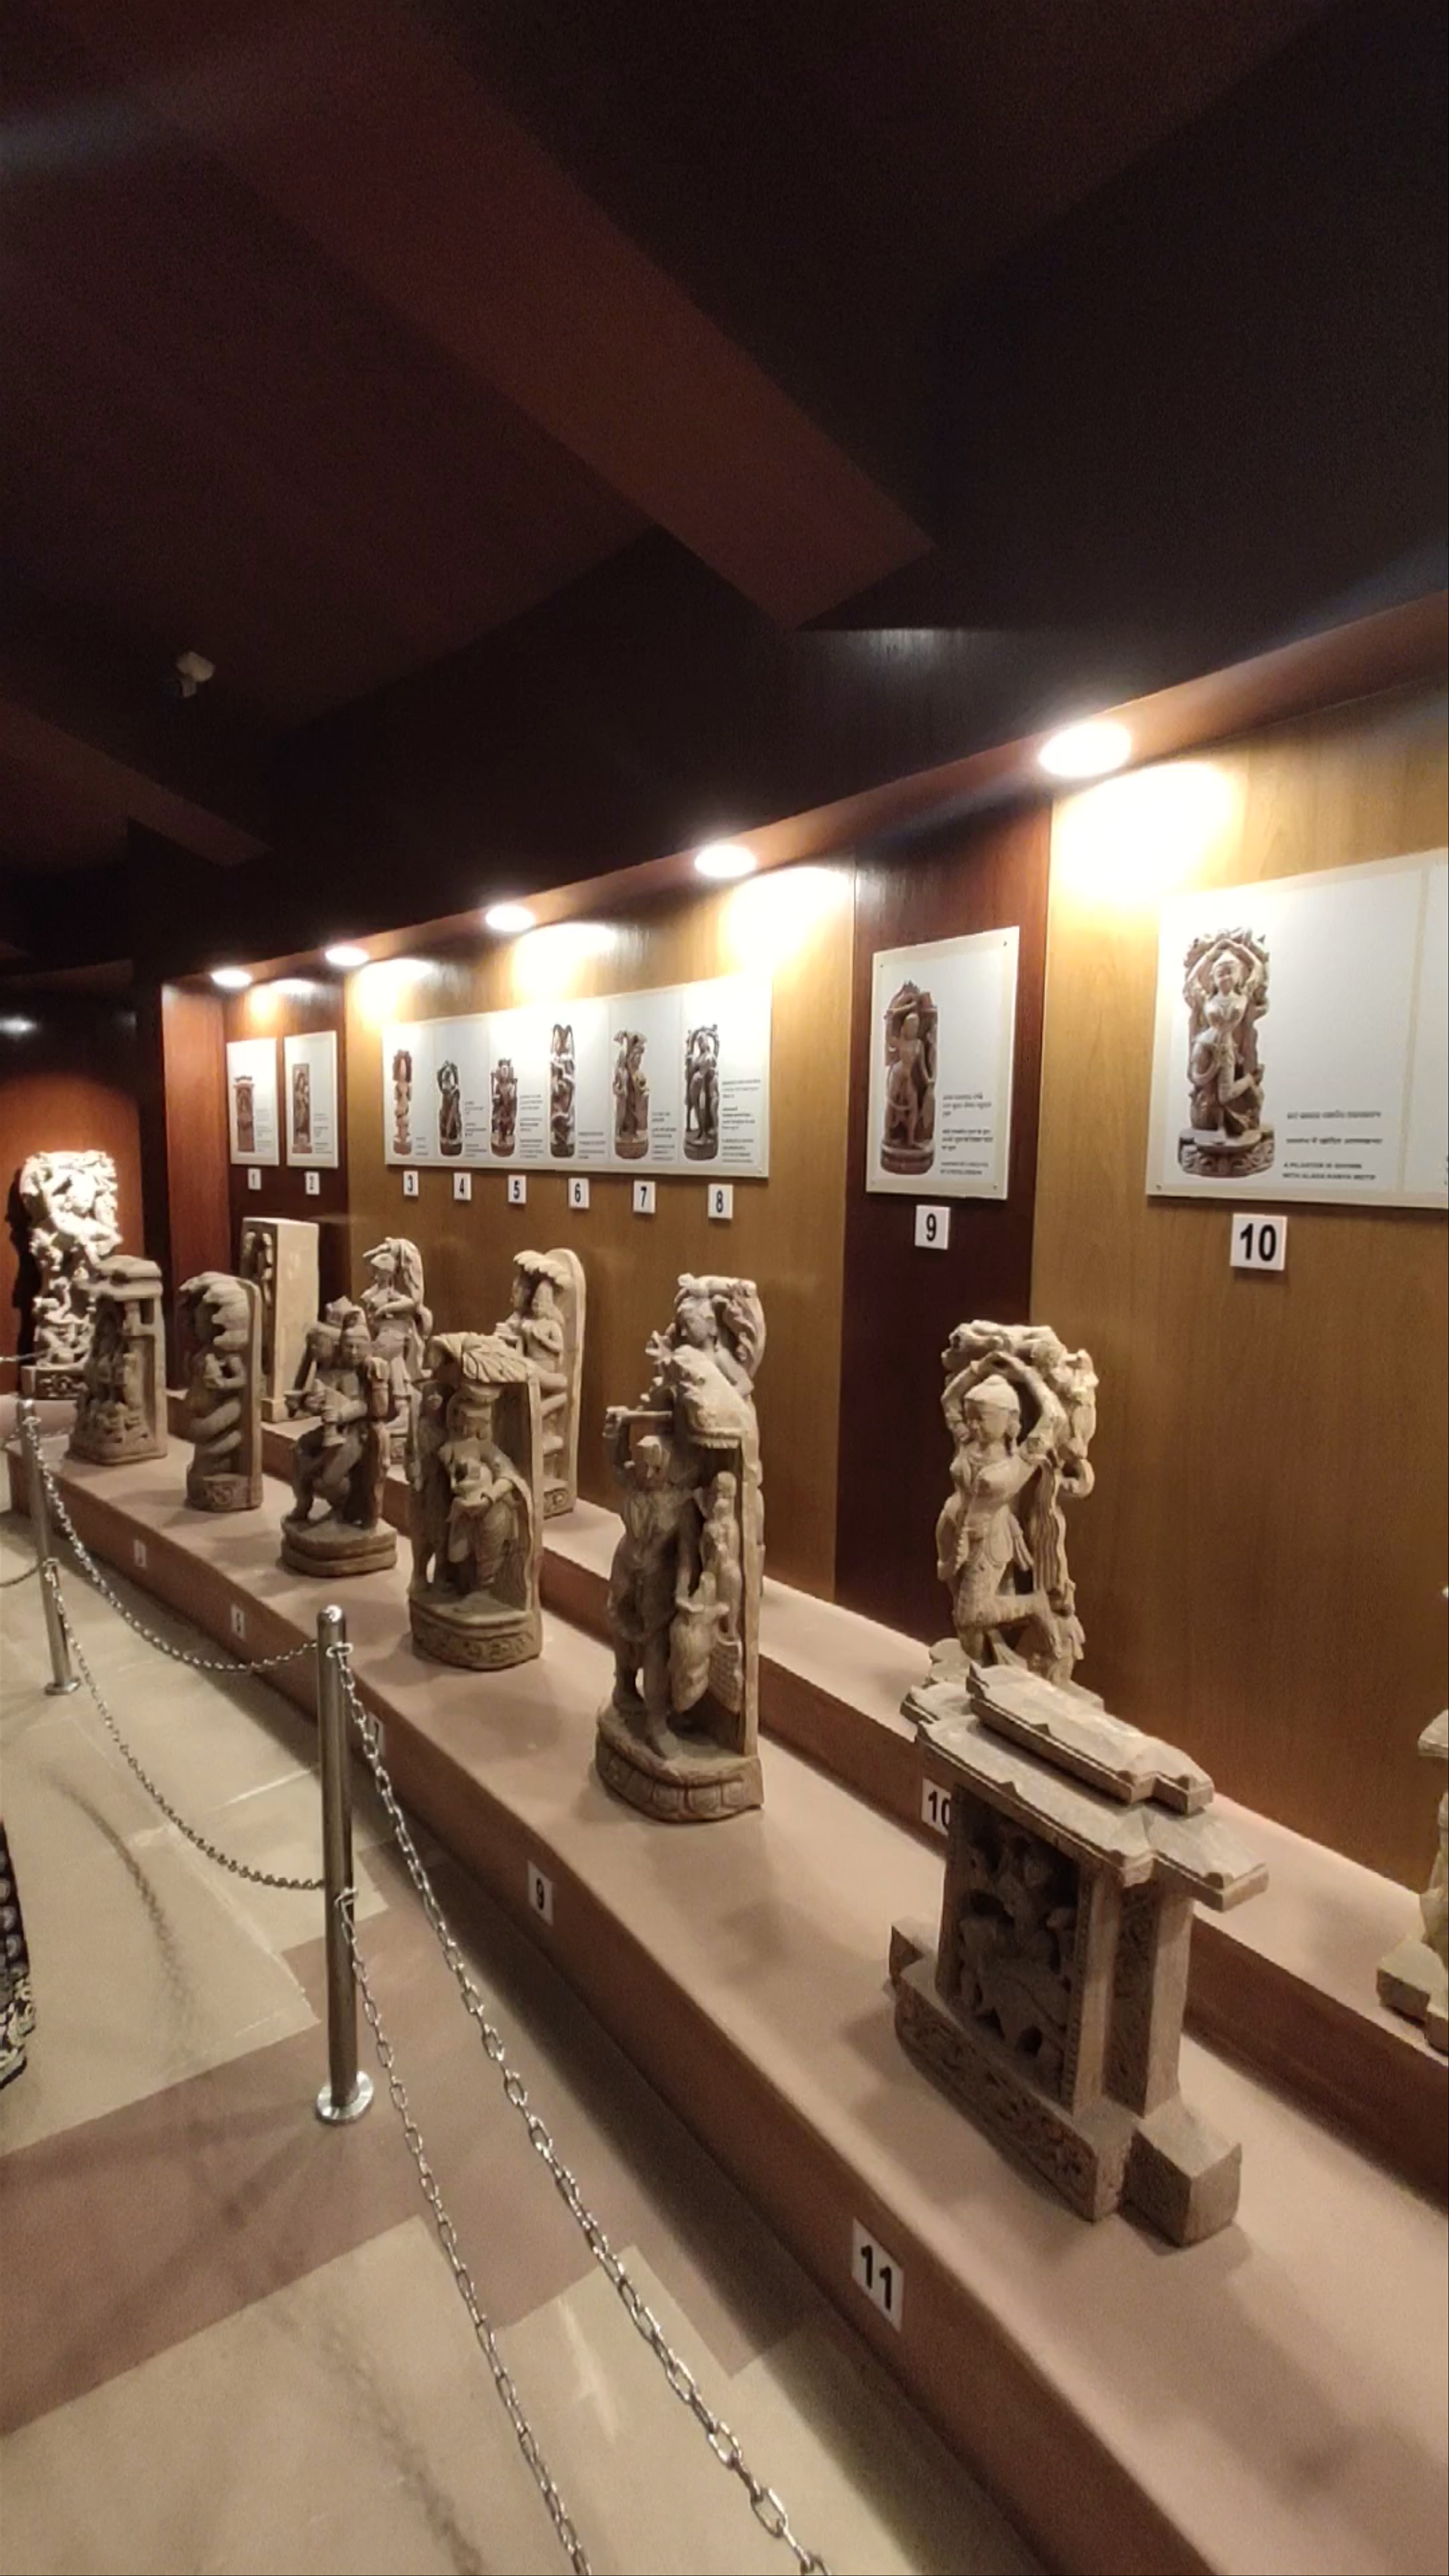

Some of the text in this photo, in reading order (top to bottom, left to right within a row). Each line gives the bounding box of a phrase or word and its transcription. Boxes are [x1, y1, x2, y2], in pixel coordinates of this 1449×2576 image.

[408, 1175, 414, 1192] 3
[459, 1178, 465, 1196] 4
[513, 1180, 520, 1200] 5
[575, 1183, 581, 1203] 6
[640, 1186, 648, 1208] 7
[716, 1190, 724, 1213] 8
[926, 1213, 937, 1242] 9
[1240, 1223, 1277, 1262] 10
[536, 1878, 545, 1911] 9
[860, 2244, 892, 2312] 11
